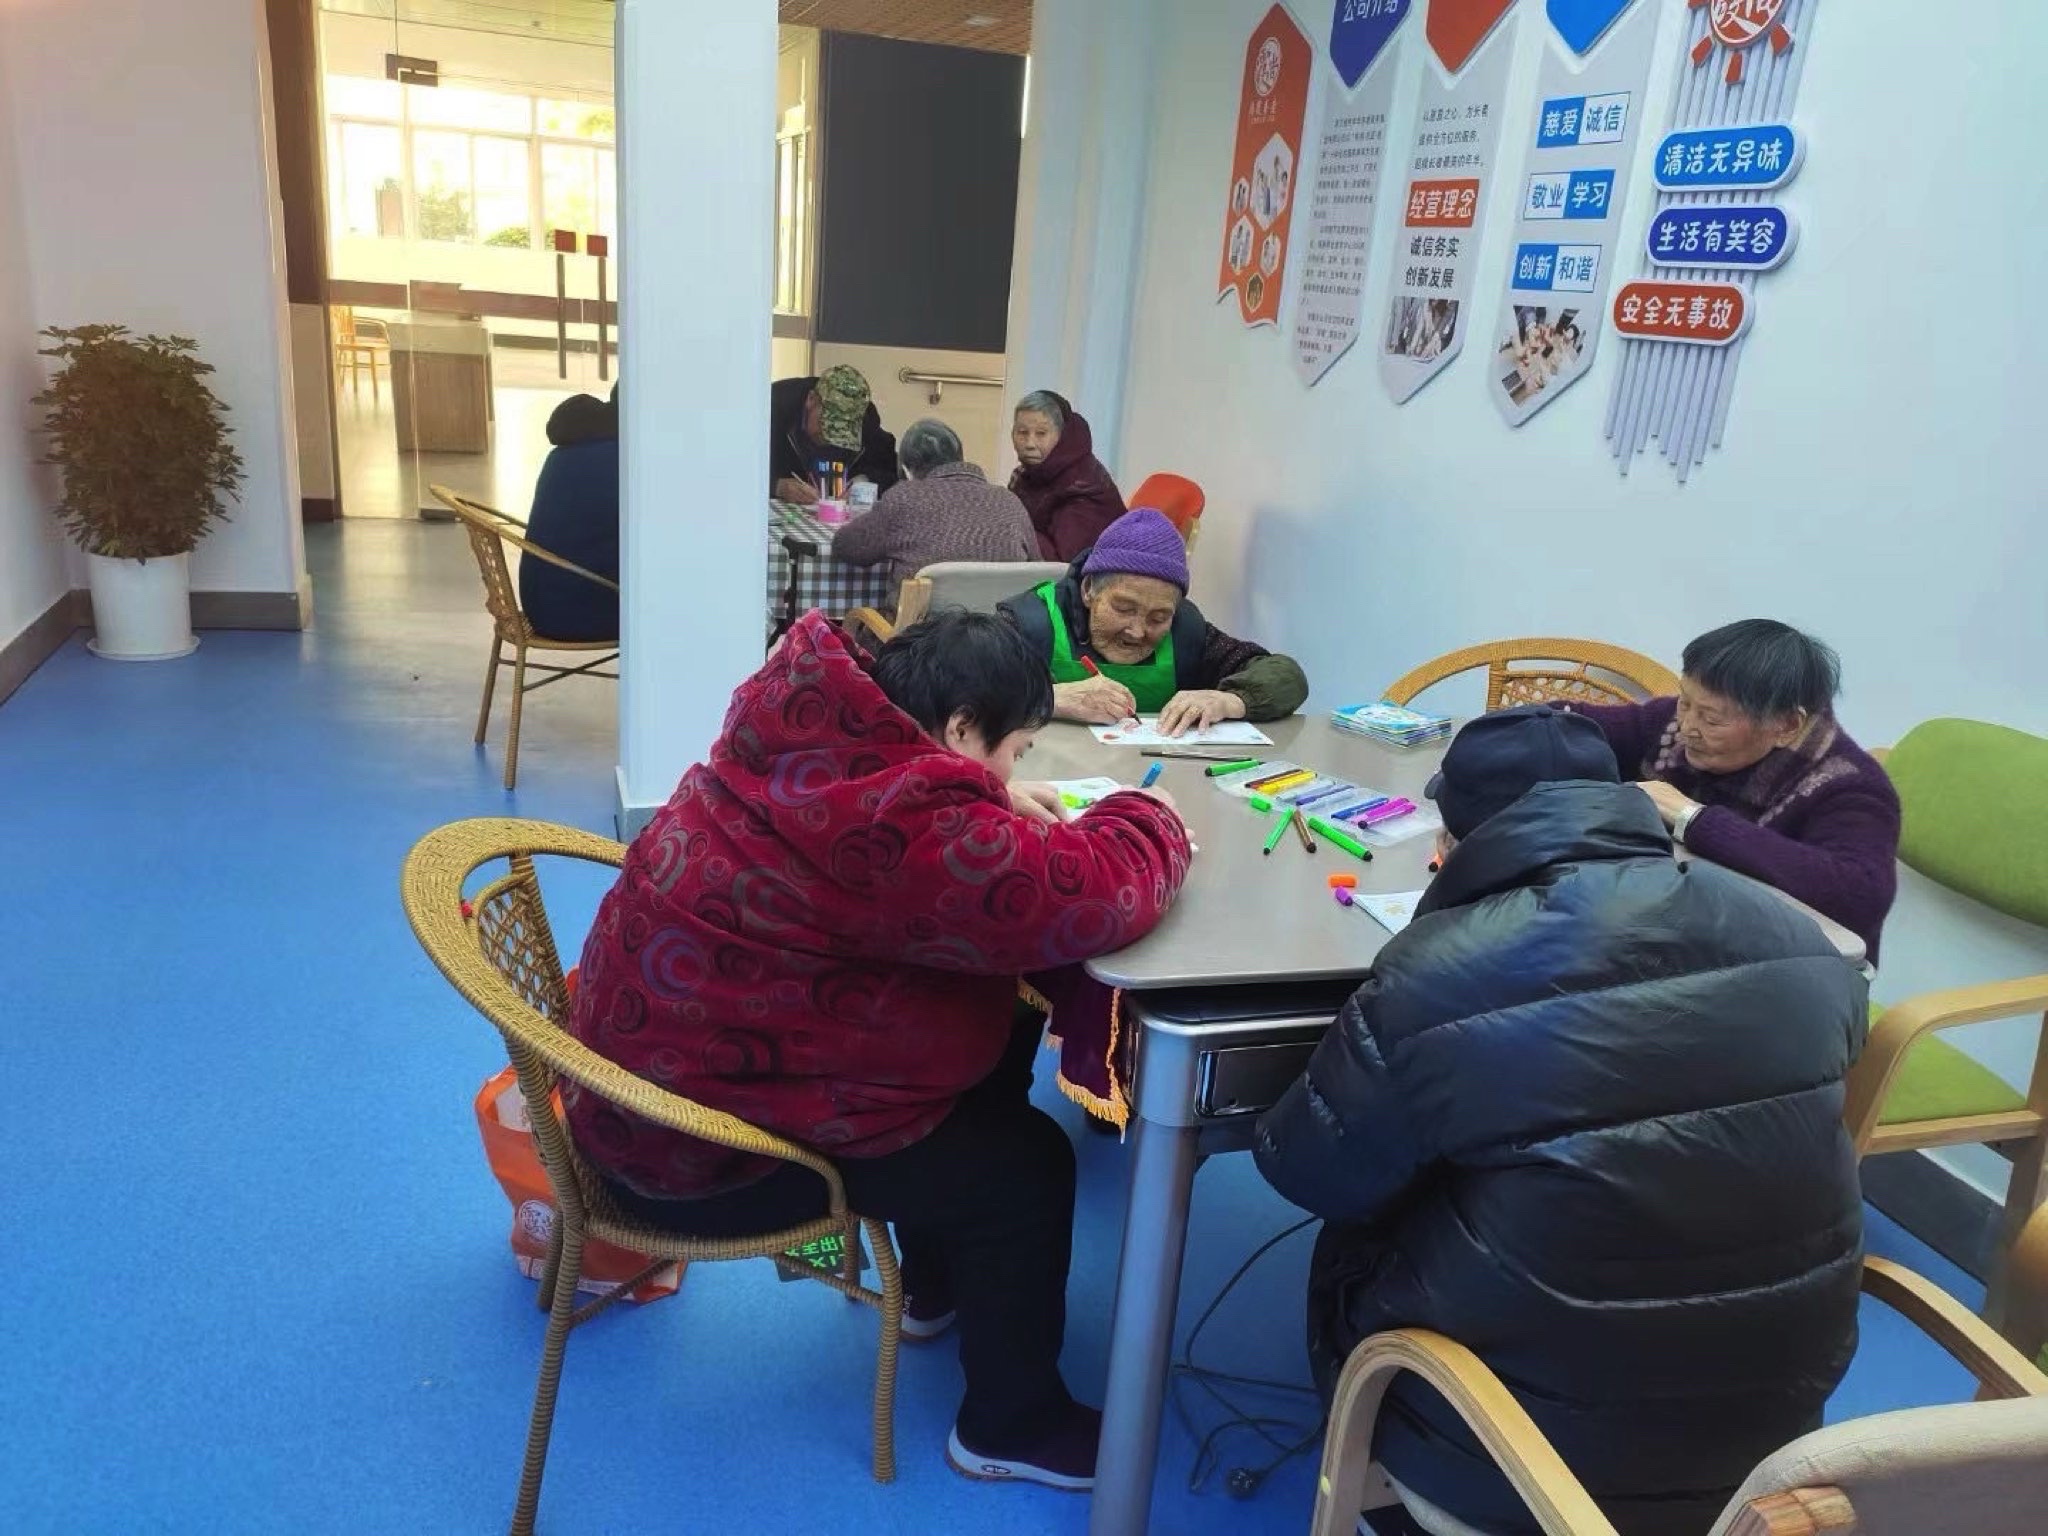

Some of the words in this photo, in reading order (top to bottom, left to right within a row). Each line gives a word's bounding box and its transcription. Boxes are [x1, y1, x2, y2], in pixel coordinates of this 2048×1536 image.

[1543, 108, 1579, 137] 慈爱
[1585, 104, 1623, 133] 诚信
[1663, 138, 1783, 176] 清洁无异味
[1408, 188, 1476, 219] 经营理念
[1531, 181, 1564, 210] 敬业
[1571, 181, 1608, 209] 学习
[1410, 235, 1460, 258] 诚信务实
[1656, 218, 1776, 254] 生活有笑容
[1405, 266, 1454, 289] 创新发展
[1518, 254, 1552, 281] 创新
[1558, 255, 1594, 282] 和谐
[1620, 294, 1734, 330] 安全无事故
